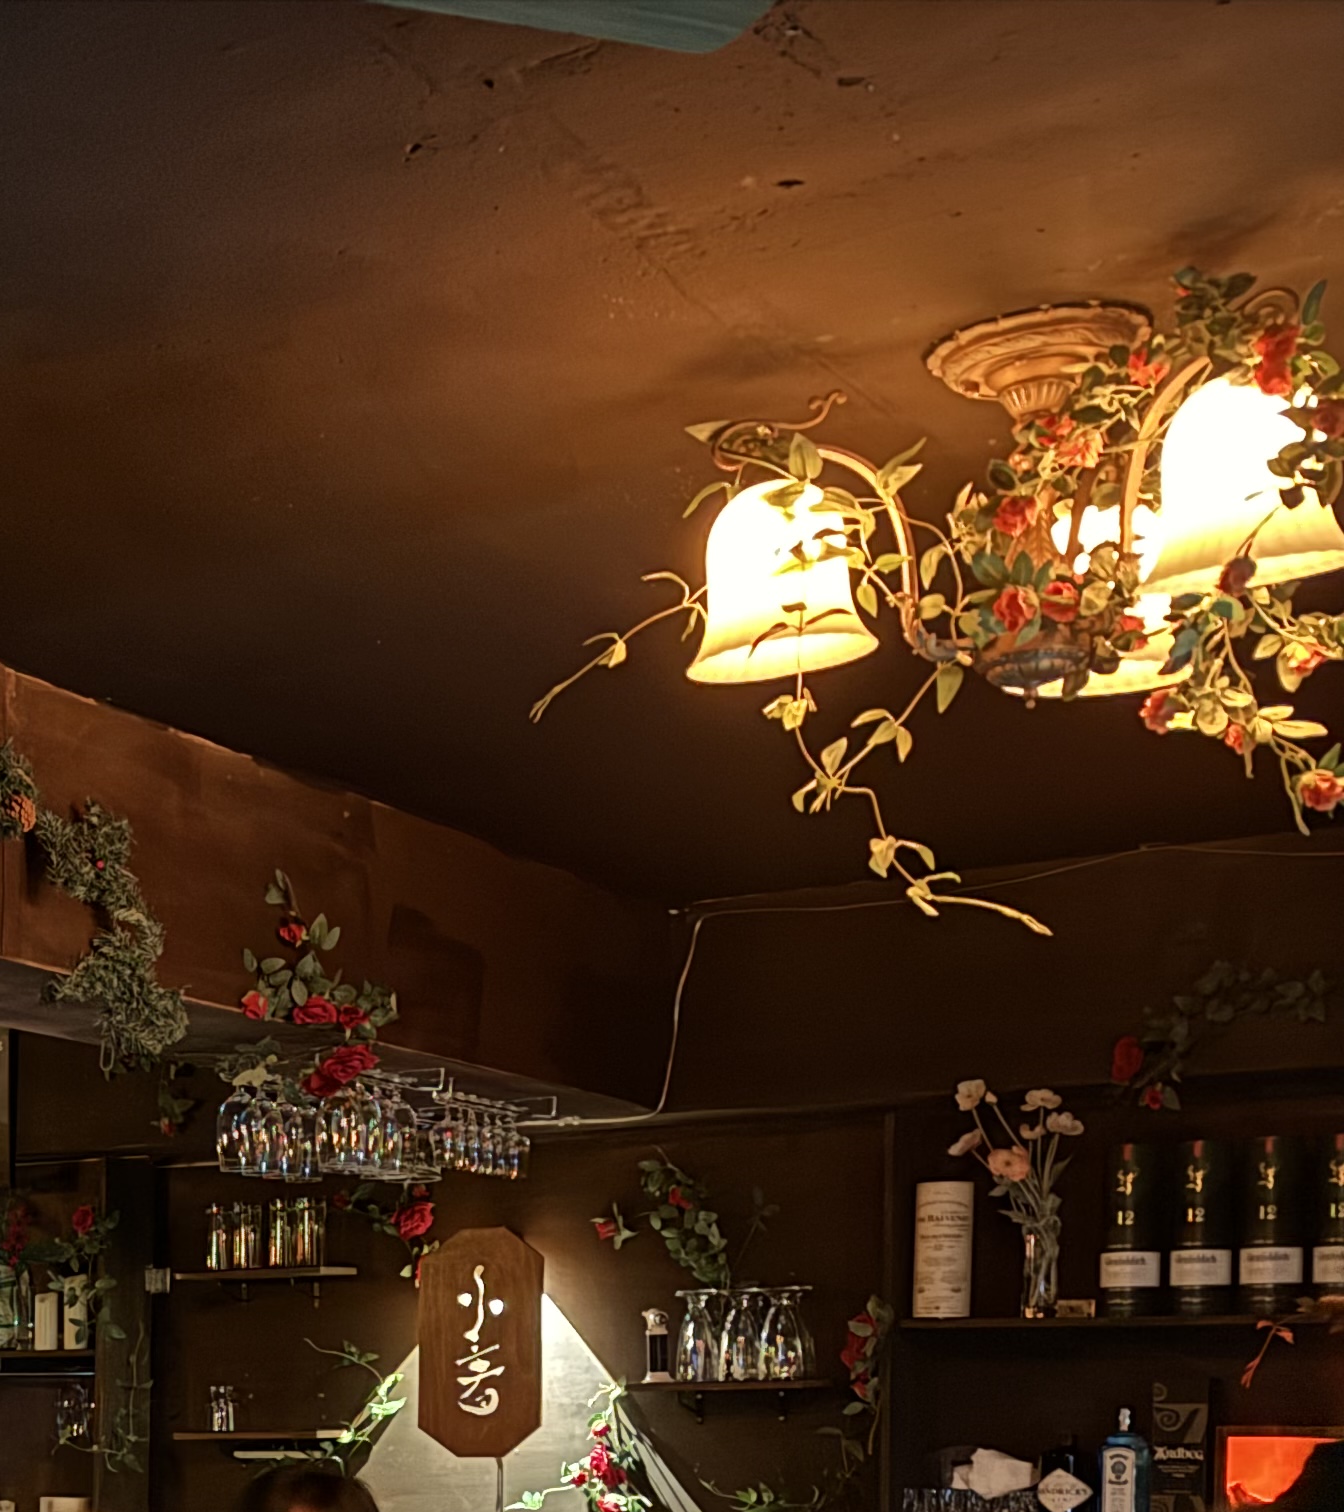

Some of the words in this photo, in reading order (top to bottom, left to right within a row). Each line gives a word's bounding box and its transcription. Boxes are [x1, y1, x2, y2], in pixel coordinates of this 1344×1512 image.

[1117, 1210, 1135, 1225] 12
[1187, 1207, 1206, 1222] 12
[1259, 1204, 1277, 1220] 12
